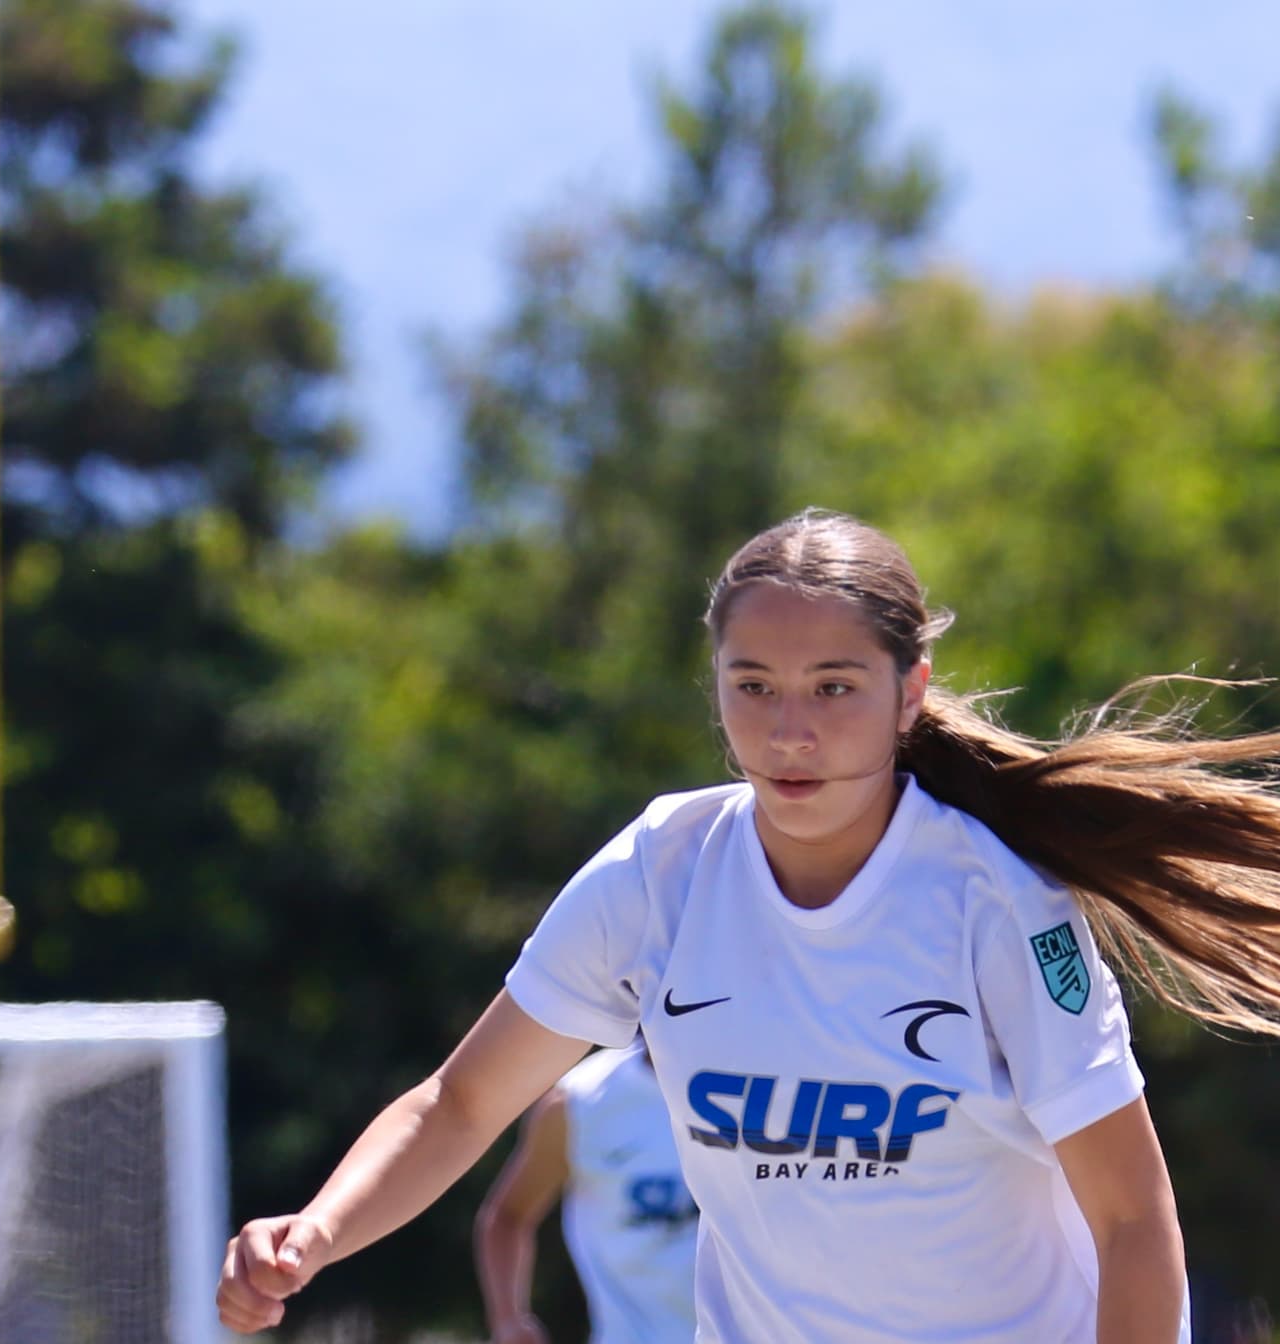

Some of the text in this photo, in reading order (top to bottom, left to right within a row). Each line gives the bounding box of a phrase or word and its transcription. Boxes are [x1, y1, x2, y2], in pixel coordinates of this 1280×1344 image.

[1033, 926, 1078, 965] ECNL
[687, 1069, 962, 1163] SURF
[755, 1163, 808, 1180] BAY
